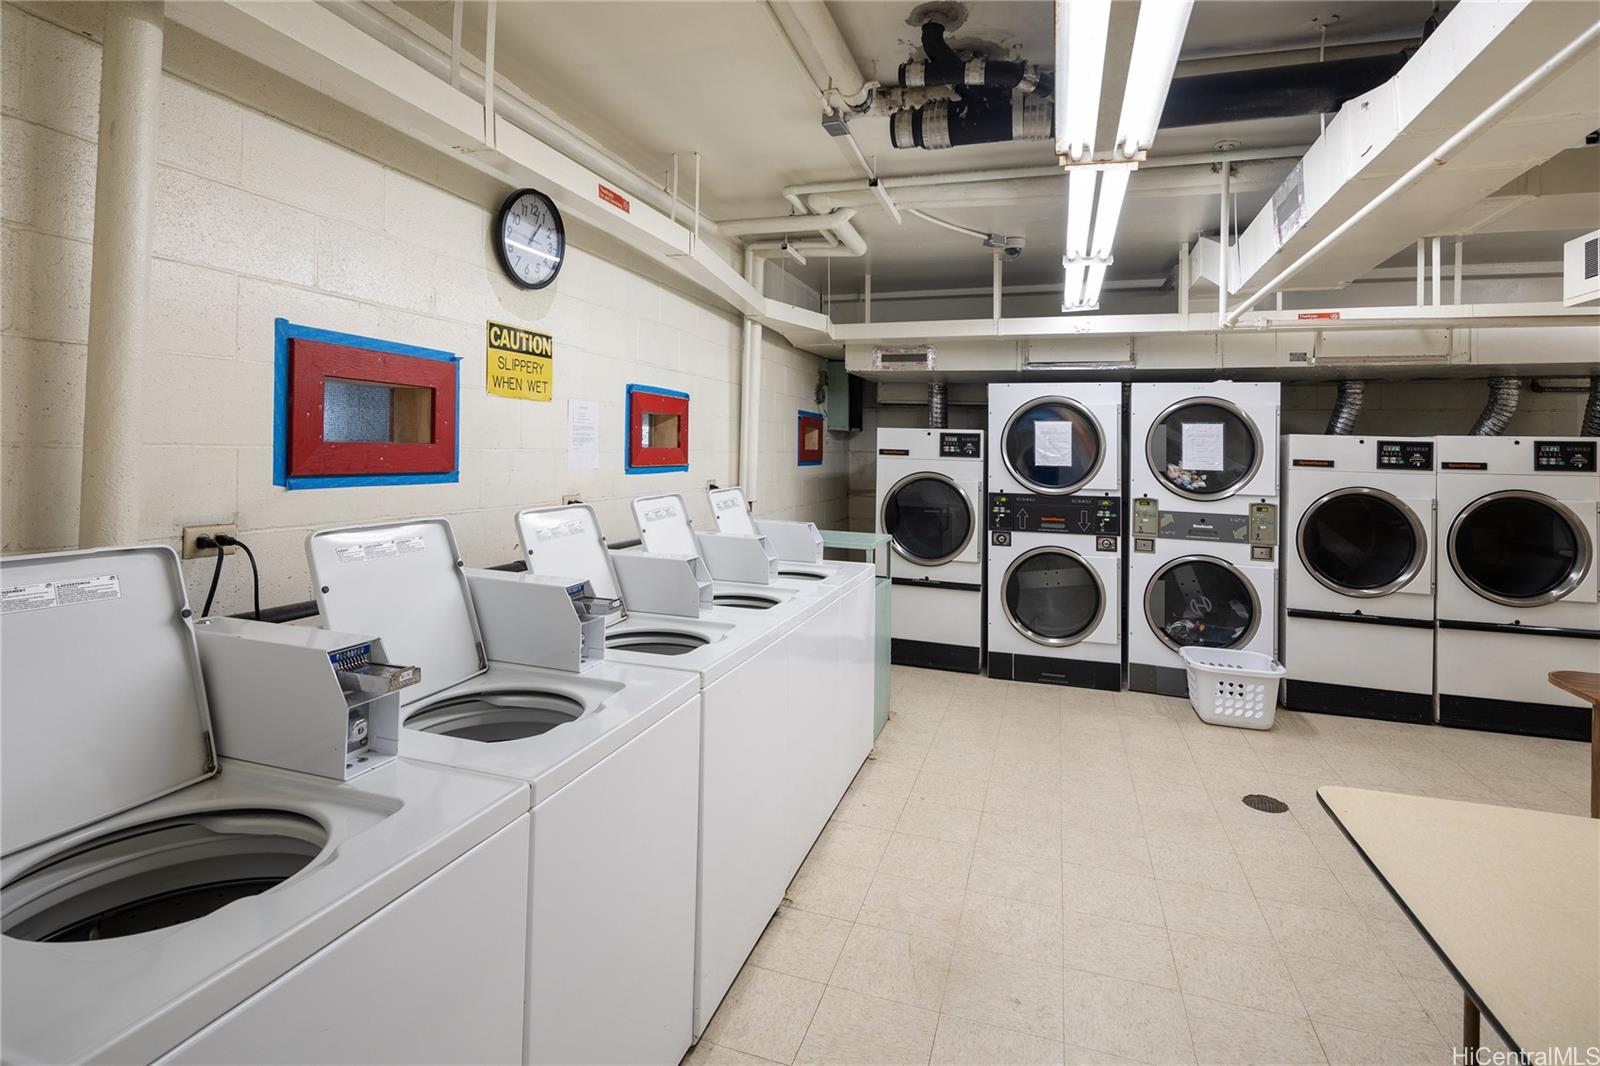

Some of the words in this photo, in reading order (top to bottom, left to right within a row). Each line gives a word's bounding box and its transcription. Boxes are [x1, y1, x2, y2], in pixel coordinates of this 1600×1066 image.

[522, 204, 528, 216] 11
[530, 203, 539, 217] 12
[512, 212, 520, 226] 10
[506, 225, 513, 237] 9
[546, 227, 552, 240] 2
[547, 243, 553, 253] 3
[515, 255, 521, 267] 7
[524, 264, 529, 275] 6
[535, 263, 541, 274] 5
[490, 326, 551, 356] CAUTION
[497, 355, 544, 375] SLIPPERY
[492, 375, 523, 391] WHEN
[527, 380, 549, 394] WET
